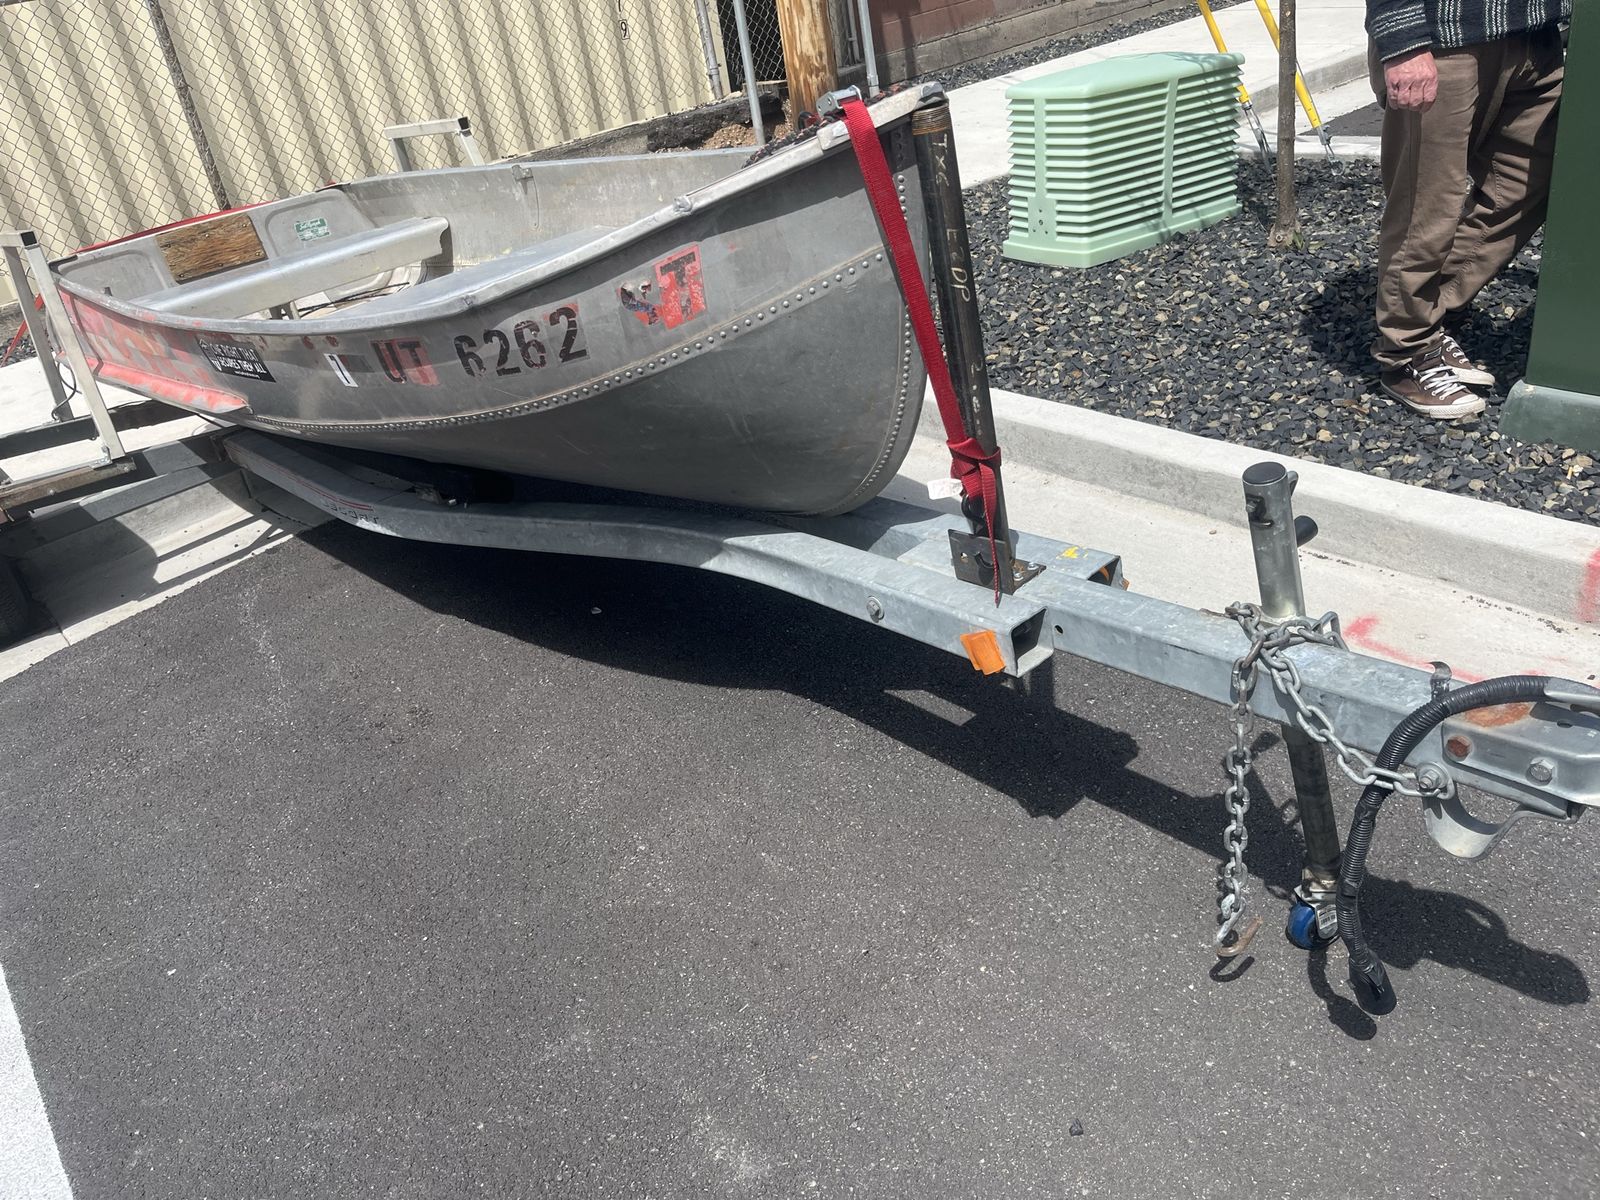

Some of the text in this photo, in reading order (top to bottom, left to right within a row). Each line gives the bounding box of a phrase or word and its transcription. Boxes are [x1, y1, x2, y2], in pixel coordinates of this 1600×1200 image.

[369, 339, 432, 384] UT
[454, 306, 587, 376] 6262
[238, 347, 259, 362] THAT
[237, 359, 254, 372] THEM
[253, 362, 268, 374] ALL
